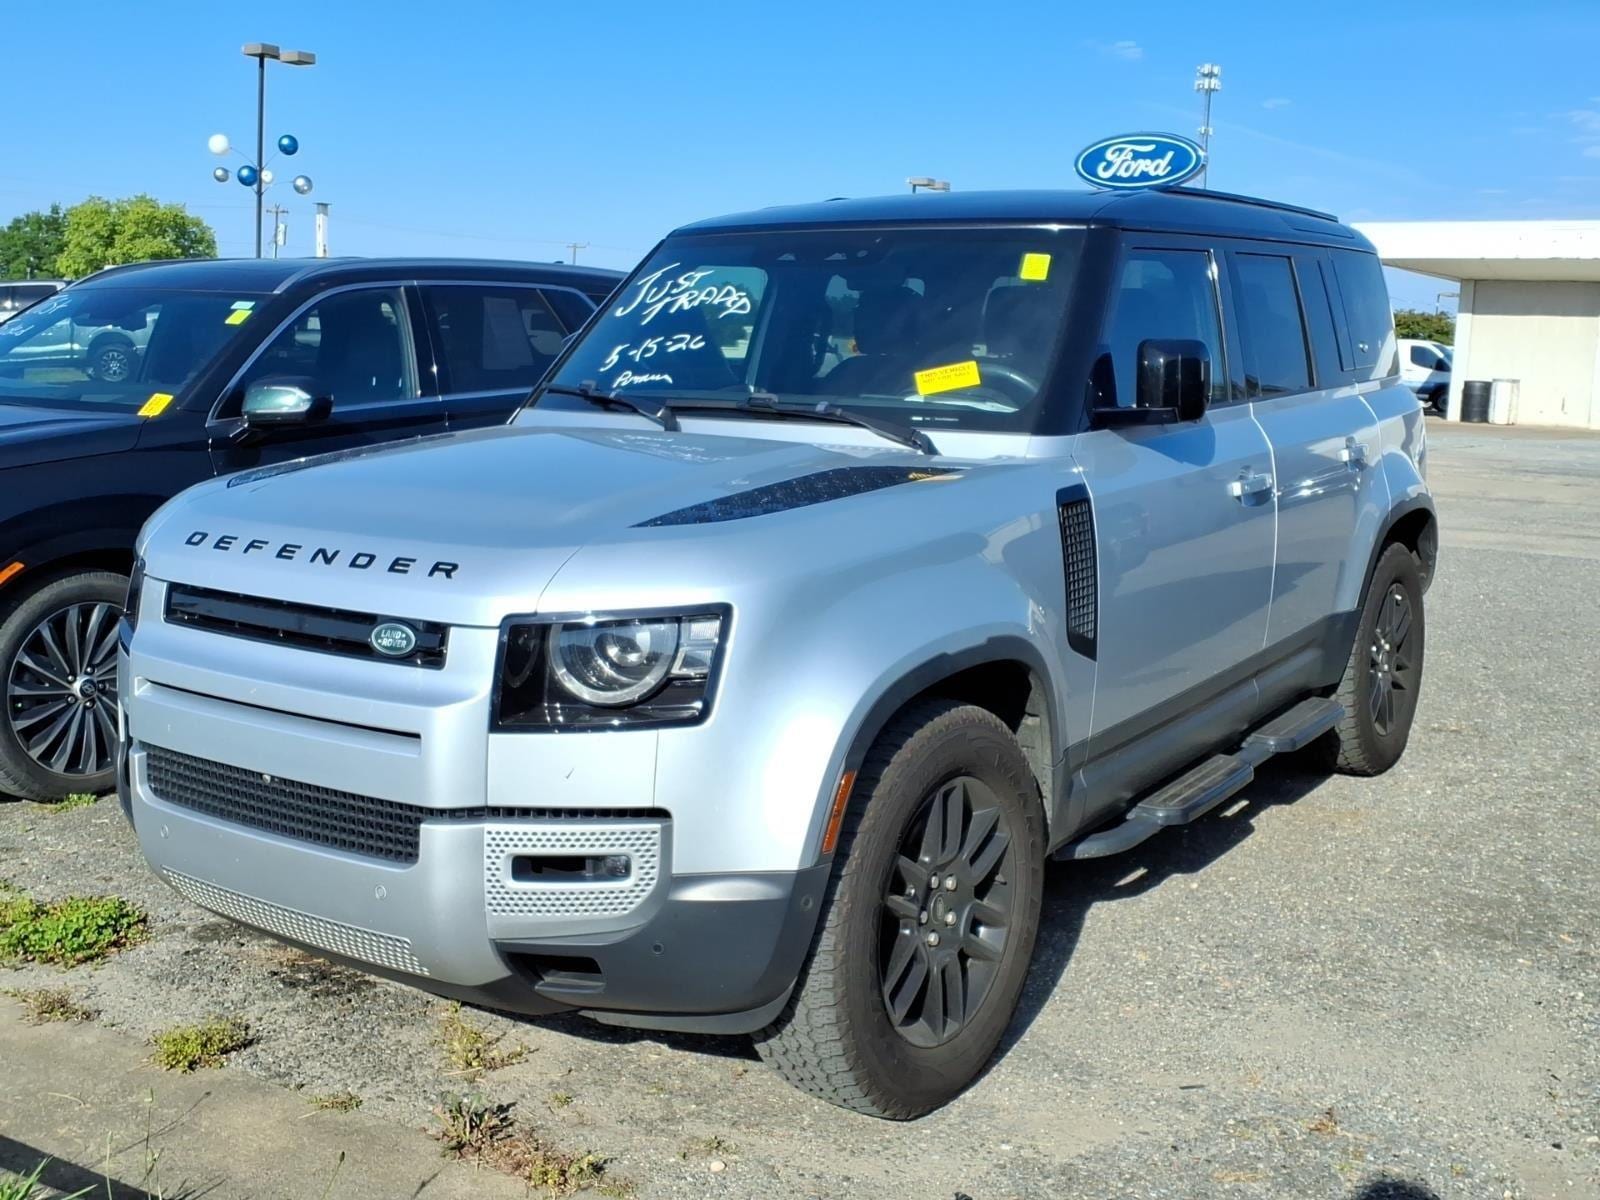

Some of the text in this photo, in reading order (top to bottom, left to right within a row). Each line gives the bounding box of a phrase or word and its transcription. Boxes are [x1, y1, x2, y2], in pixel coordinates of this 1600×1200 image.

[1097, 143, 1175, 179] Ford
[615, 262, 715, 317] JUST
[642, 285, 751, 326] TRADED
[184, 530, 459, 580] DEFENDER
[380, 629, 402, 639] LAND
[381, 637, 407, 649] ROVER
